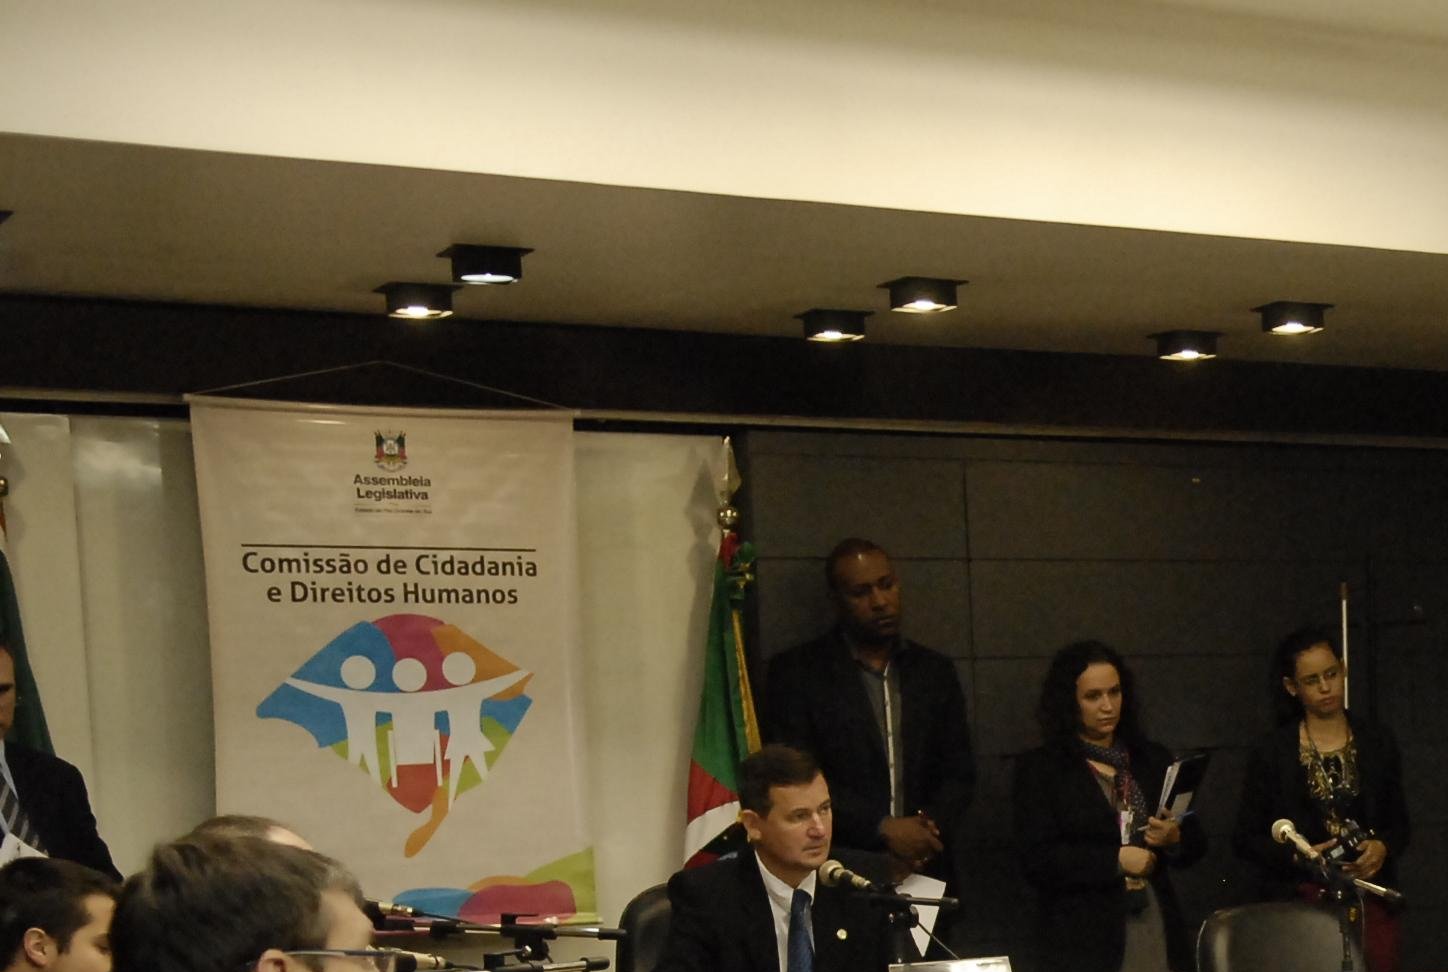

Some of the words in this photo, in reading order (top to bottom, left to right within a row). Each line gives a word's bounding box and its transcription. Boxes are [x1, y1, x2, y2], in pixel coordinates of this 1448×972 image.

[353, 473, 431, 487] Assembleia
[356, 487, 429, 501] Legislativa
[242, 551, 369, 575] Comissão
[376, 553, 408, 575] de
[415, 554, 537, 577] Cidadania
[267, 586, 282, 603] e
[290, 580, 396, 604] Direitos
[402, 582, 519, 605] Humanos
